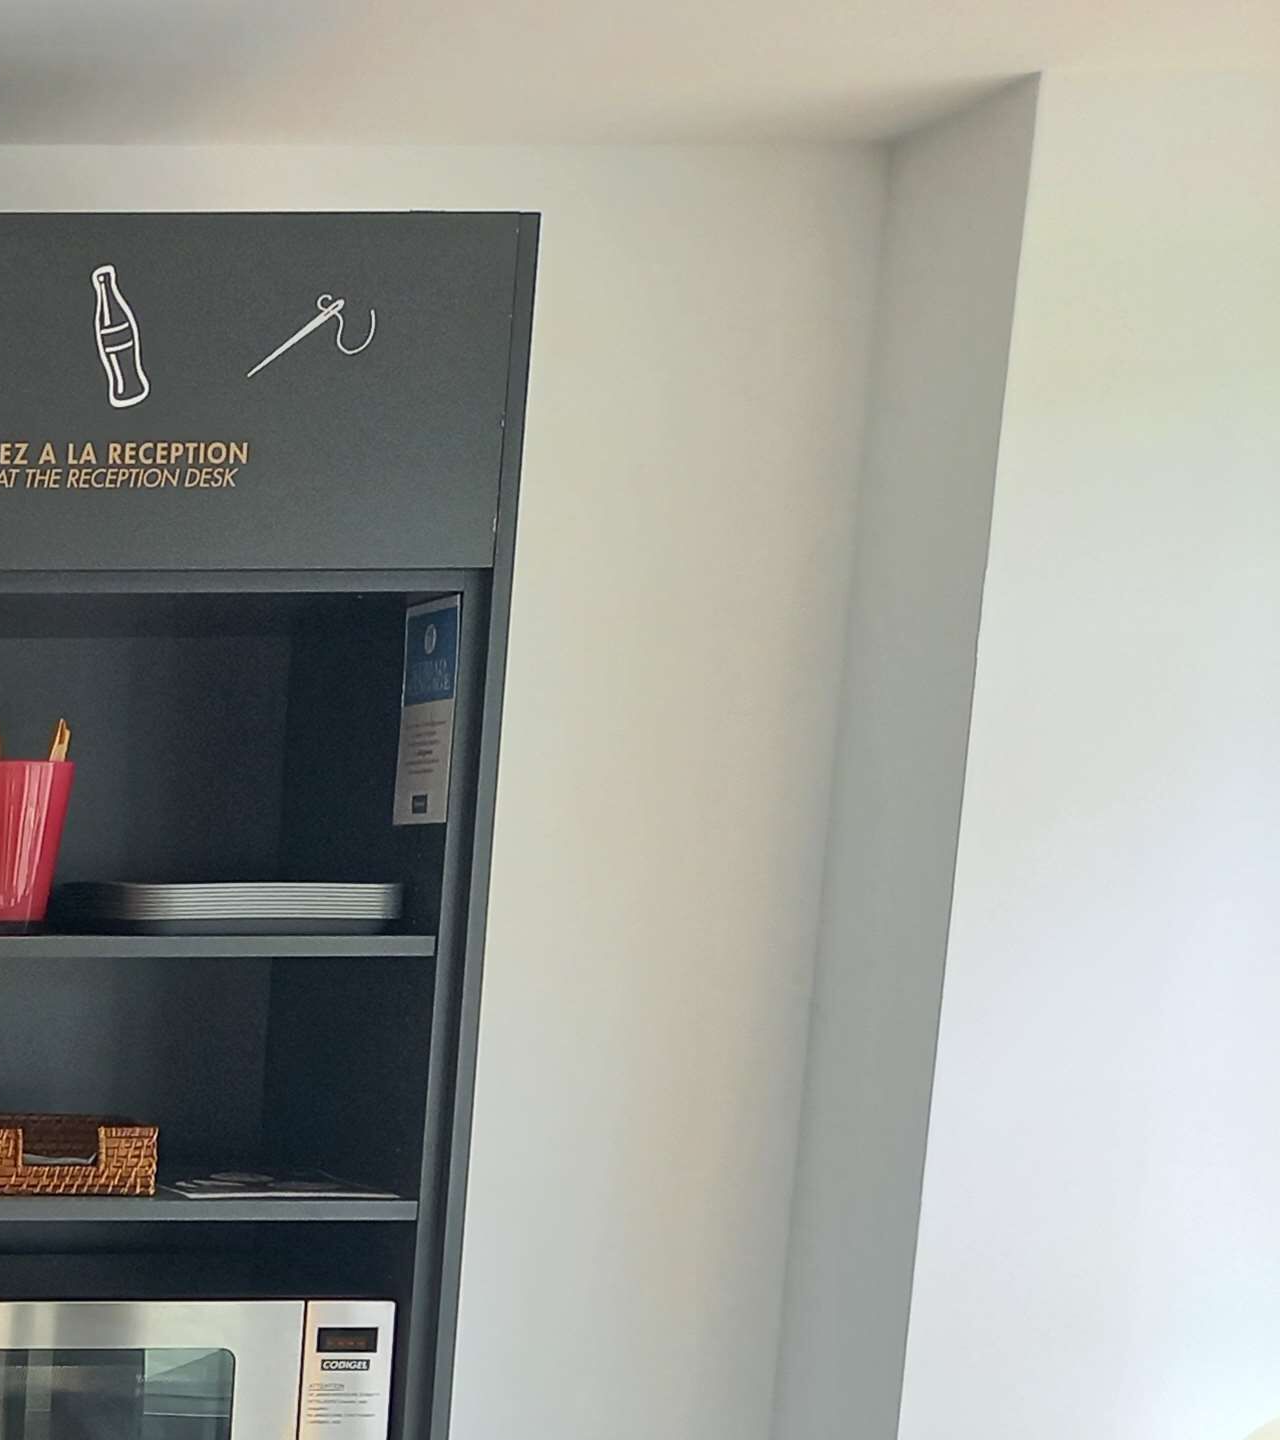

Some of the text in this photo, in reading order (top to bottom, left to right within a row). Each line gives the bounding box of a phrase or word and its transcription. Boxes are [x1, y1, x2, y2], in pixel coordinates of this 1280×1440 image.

[38, 443, 57, 465] A
[68, 443, 97, 465] LA
[108, 443, 249, 465] RECEPTION
[25, 469, 61, 489] THE
[66, 468, 180, 488] RECEPTION
[184, 468, 238, 488] DESK
[322, 1361, 368, 1370] CODIGEL
